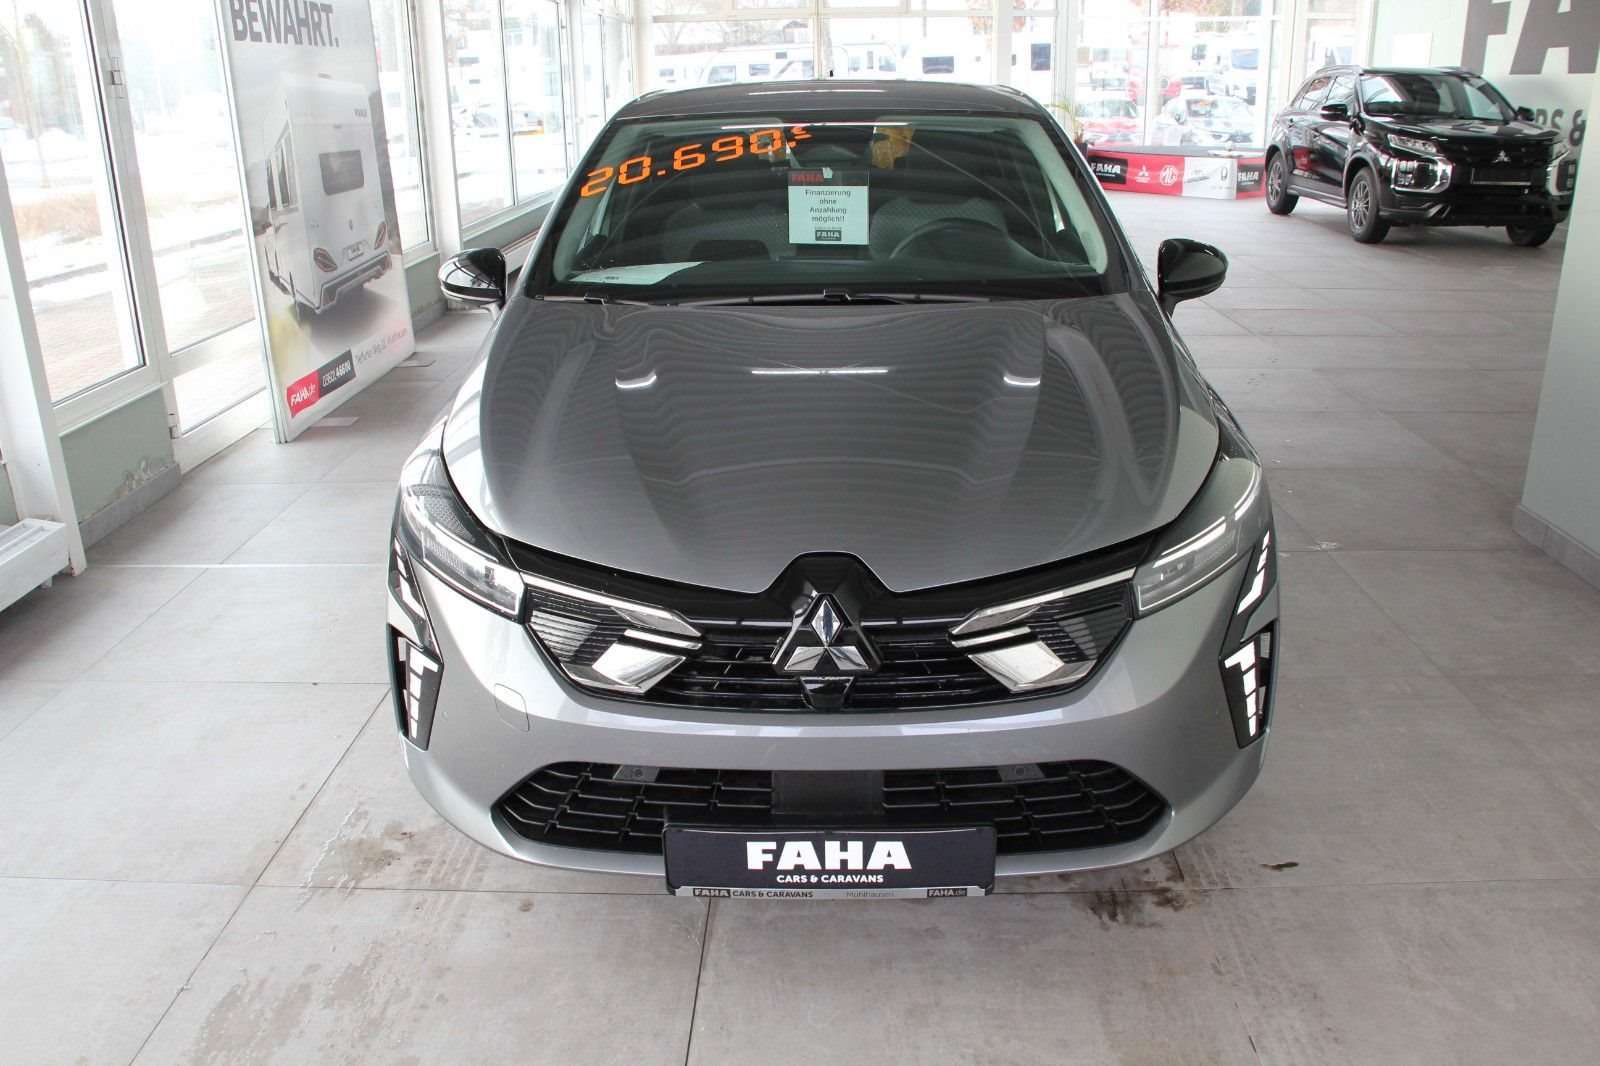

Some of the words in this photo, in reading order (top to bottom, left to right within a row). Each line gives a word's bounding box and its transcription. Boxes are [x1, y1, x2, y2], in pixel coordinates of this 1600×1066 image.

[230, 0, 340, 48] BEWAHRT.
[805, 189, 852, 198] Finanzierung
[809, 206, 847, 215] Anzahlung
[746, 840, 913, 870] FAHA
[776, 874, 808, 884] CARS
[810, 874, 819, 884] &
[821, 874, 884, 884] CARAVANS
[694, 888, 730, 897] FAHA
[766, 890, 814, 898] CARAVANS
[928, 888, 967, 897] FAHA.de
